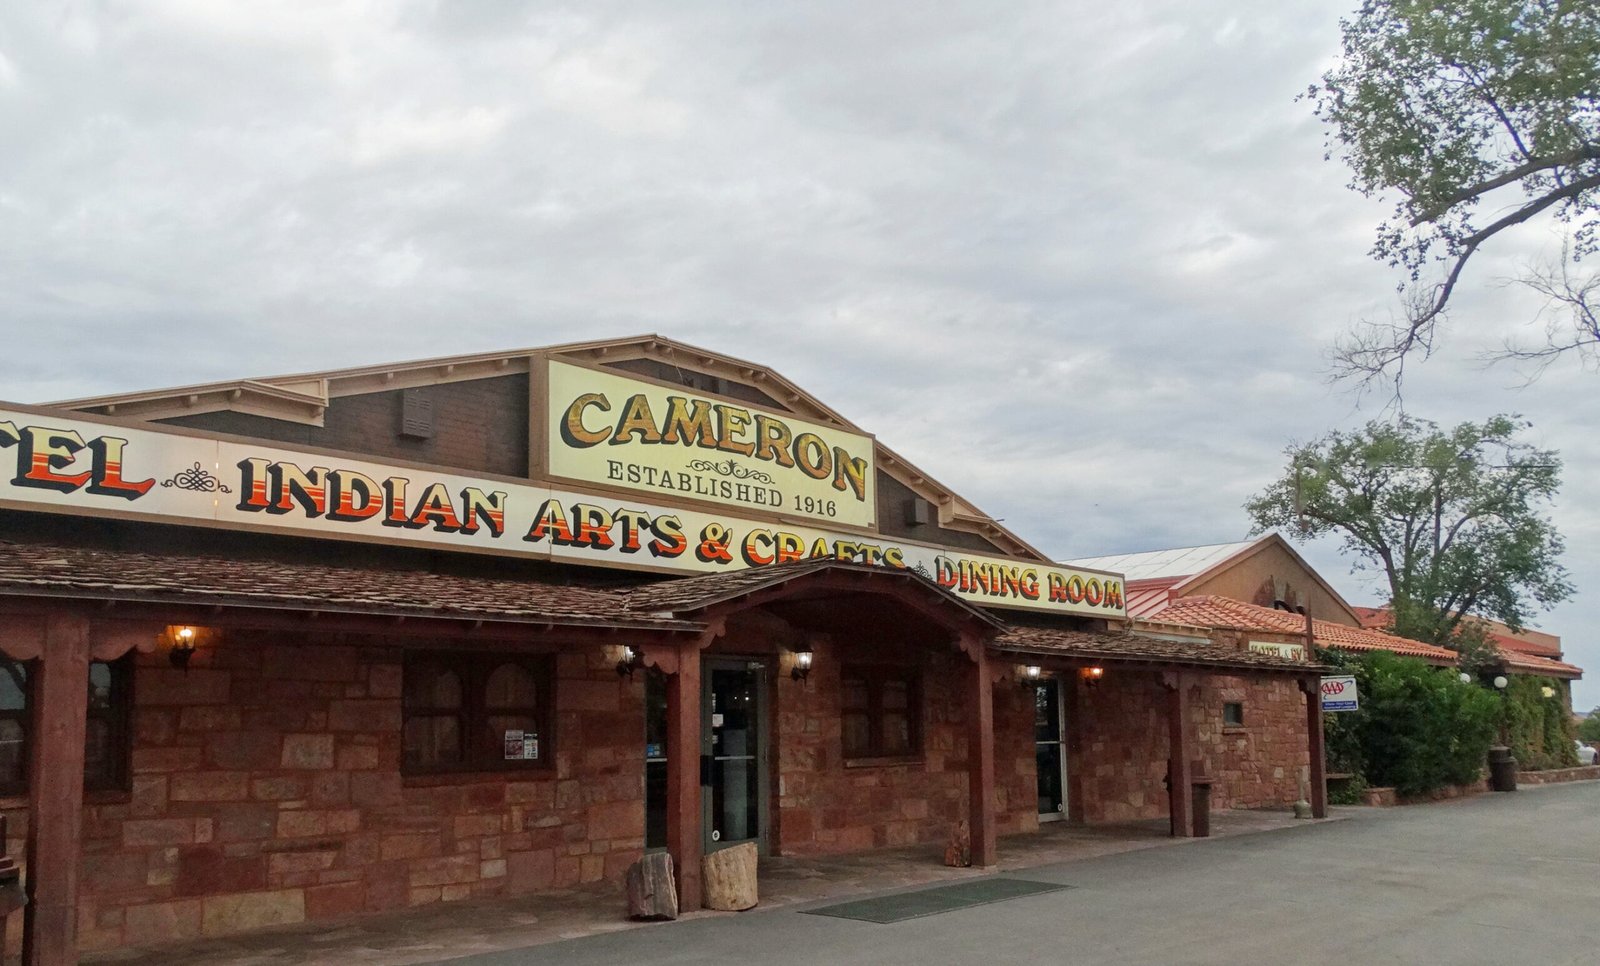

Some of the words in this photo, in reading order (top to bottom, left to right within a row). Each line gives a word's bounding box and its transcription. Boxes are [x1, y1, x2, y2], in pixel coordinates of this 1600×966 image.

[560, 393, 867, 502] CAMERON
[606, 459, 782, 507] ESTABLISHED
[794, 495, 837, 517] 1916
[236, 457, 508, 538] INDIAN
[523, 498, 687, 558] ARTS
[695, 522, 733, 565] &
[935, 554, 1040, 601] DINING
[1047, 571, 1124, 610] ROOM
[1321, 681, 1343, 694] AAA
